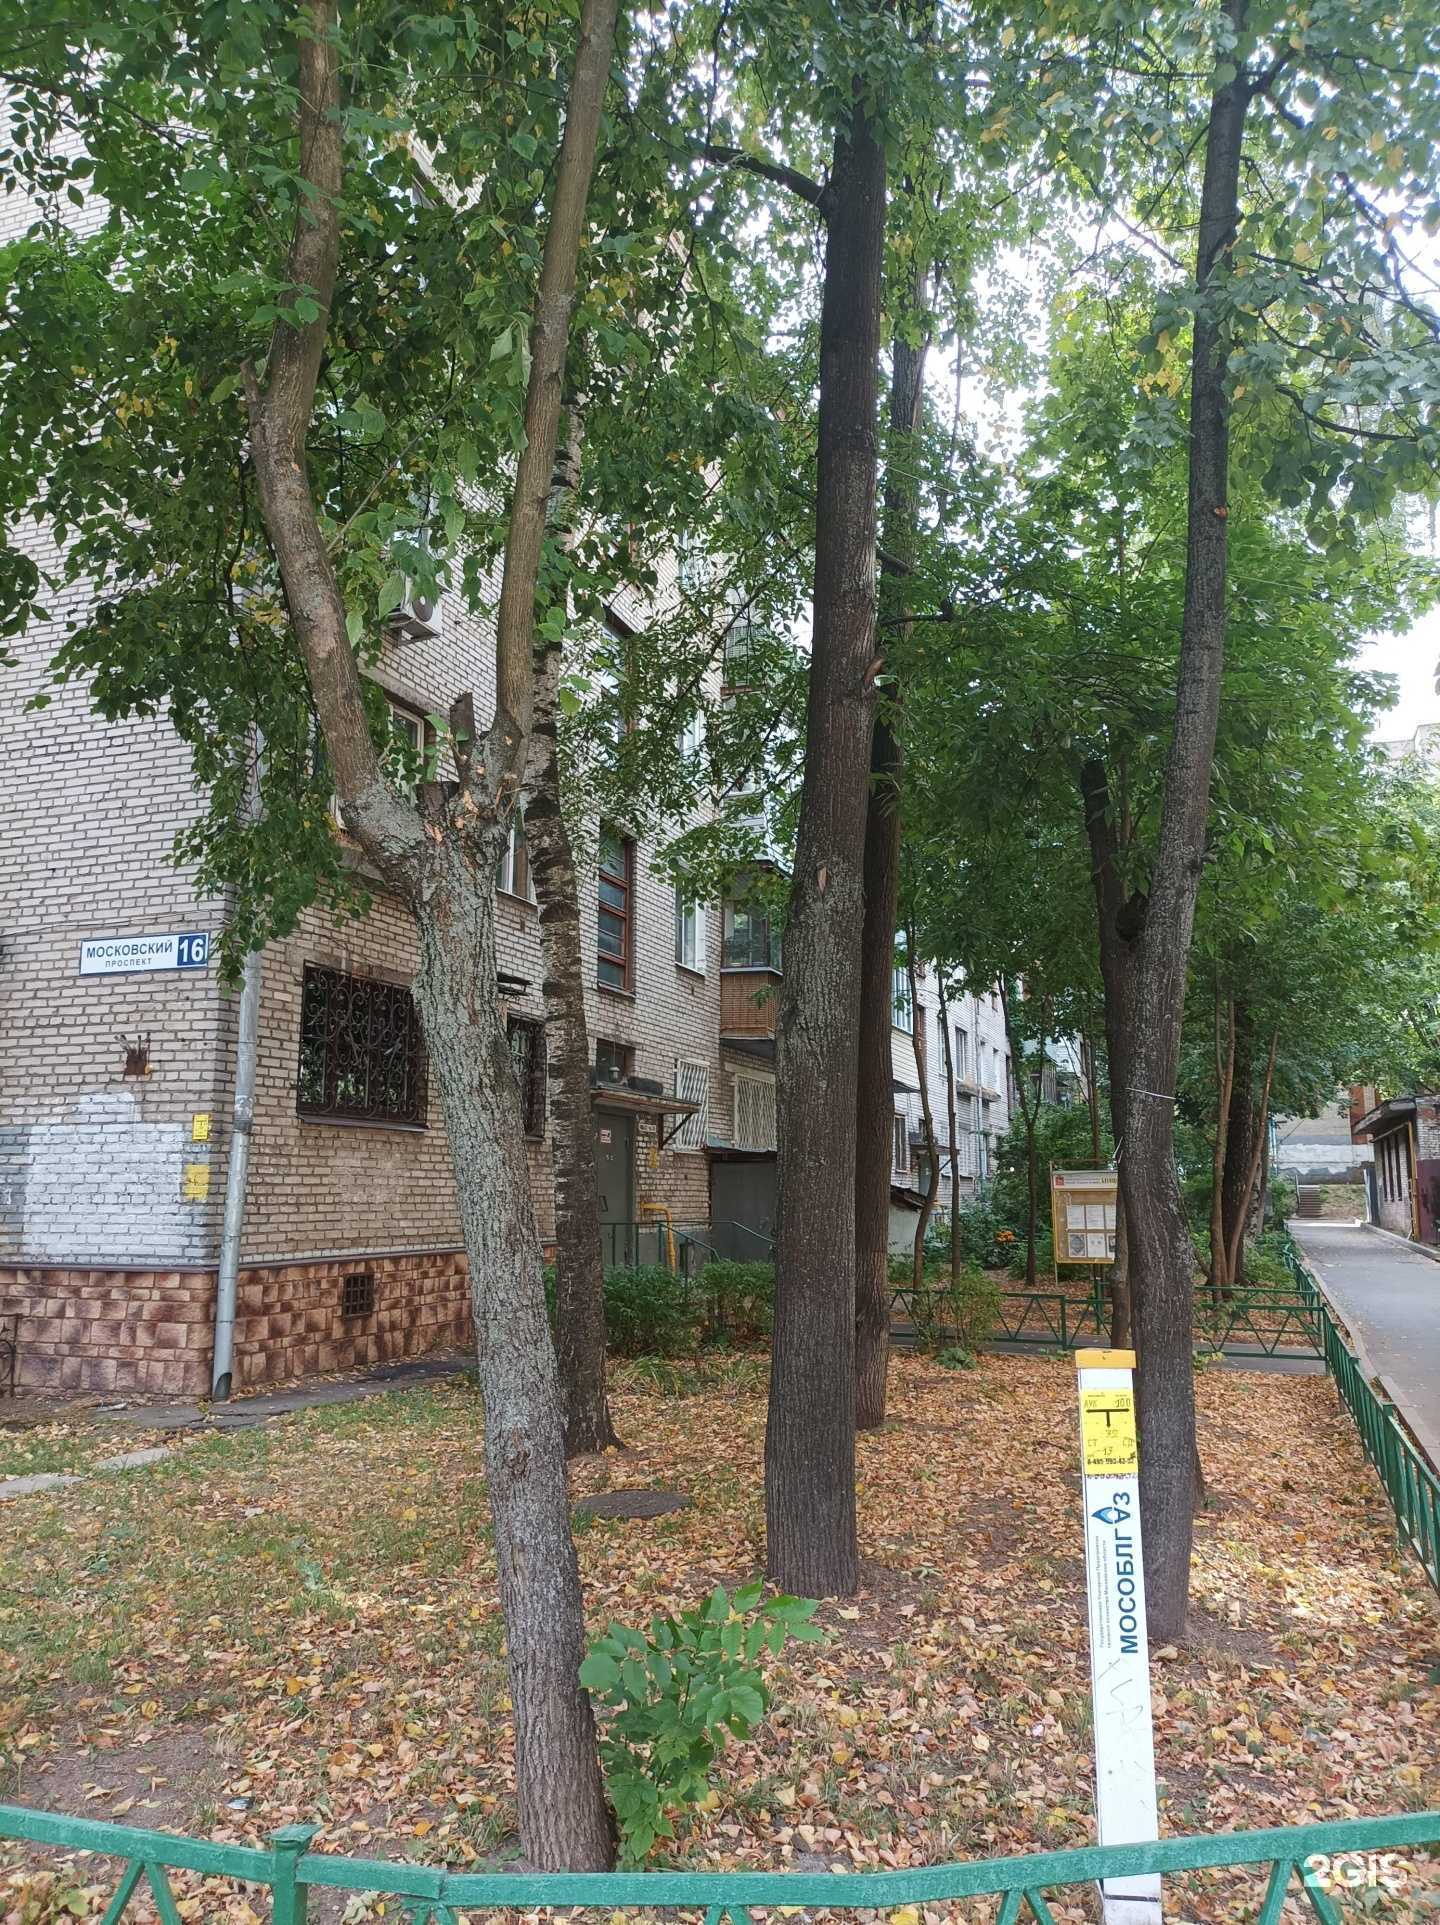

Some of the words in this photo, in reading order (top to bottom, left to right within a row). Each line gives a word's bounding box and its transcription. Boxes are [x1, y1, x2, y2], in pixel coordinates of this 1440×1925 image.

[87, 940, 173, 958] МОСКОВСКИЙ
[179, 939, 204, 962] 16
[105, 958, 153, 967] ПРОСПЕКТ
[1113, 1491, 1139, 1654] МОСОБЛГАЗ
